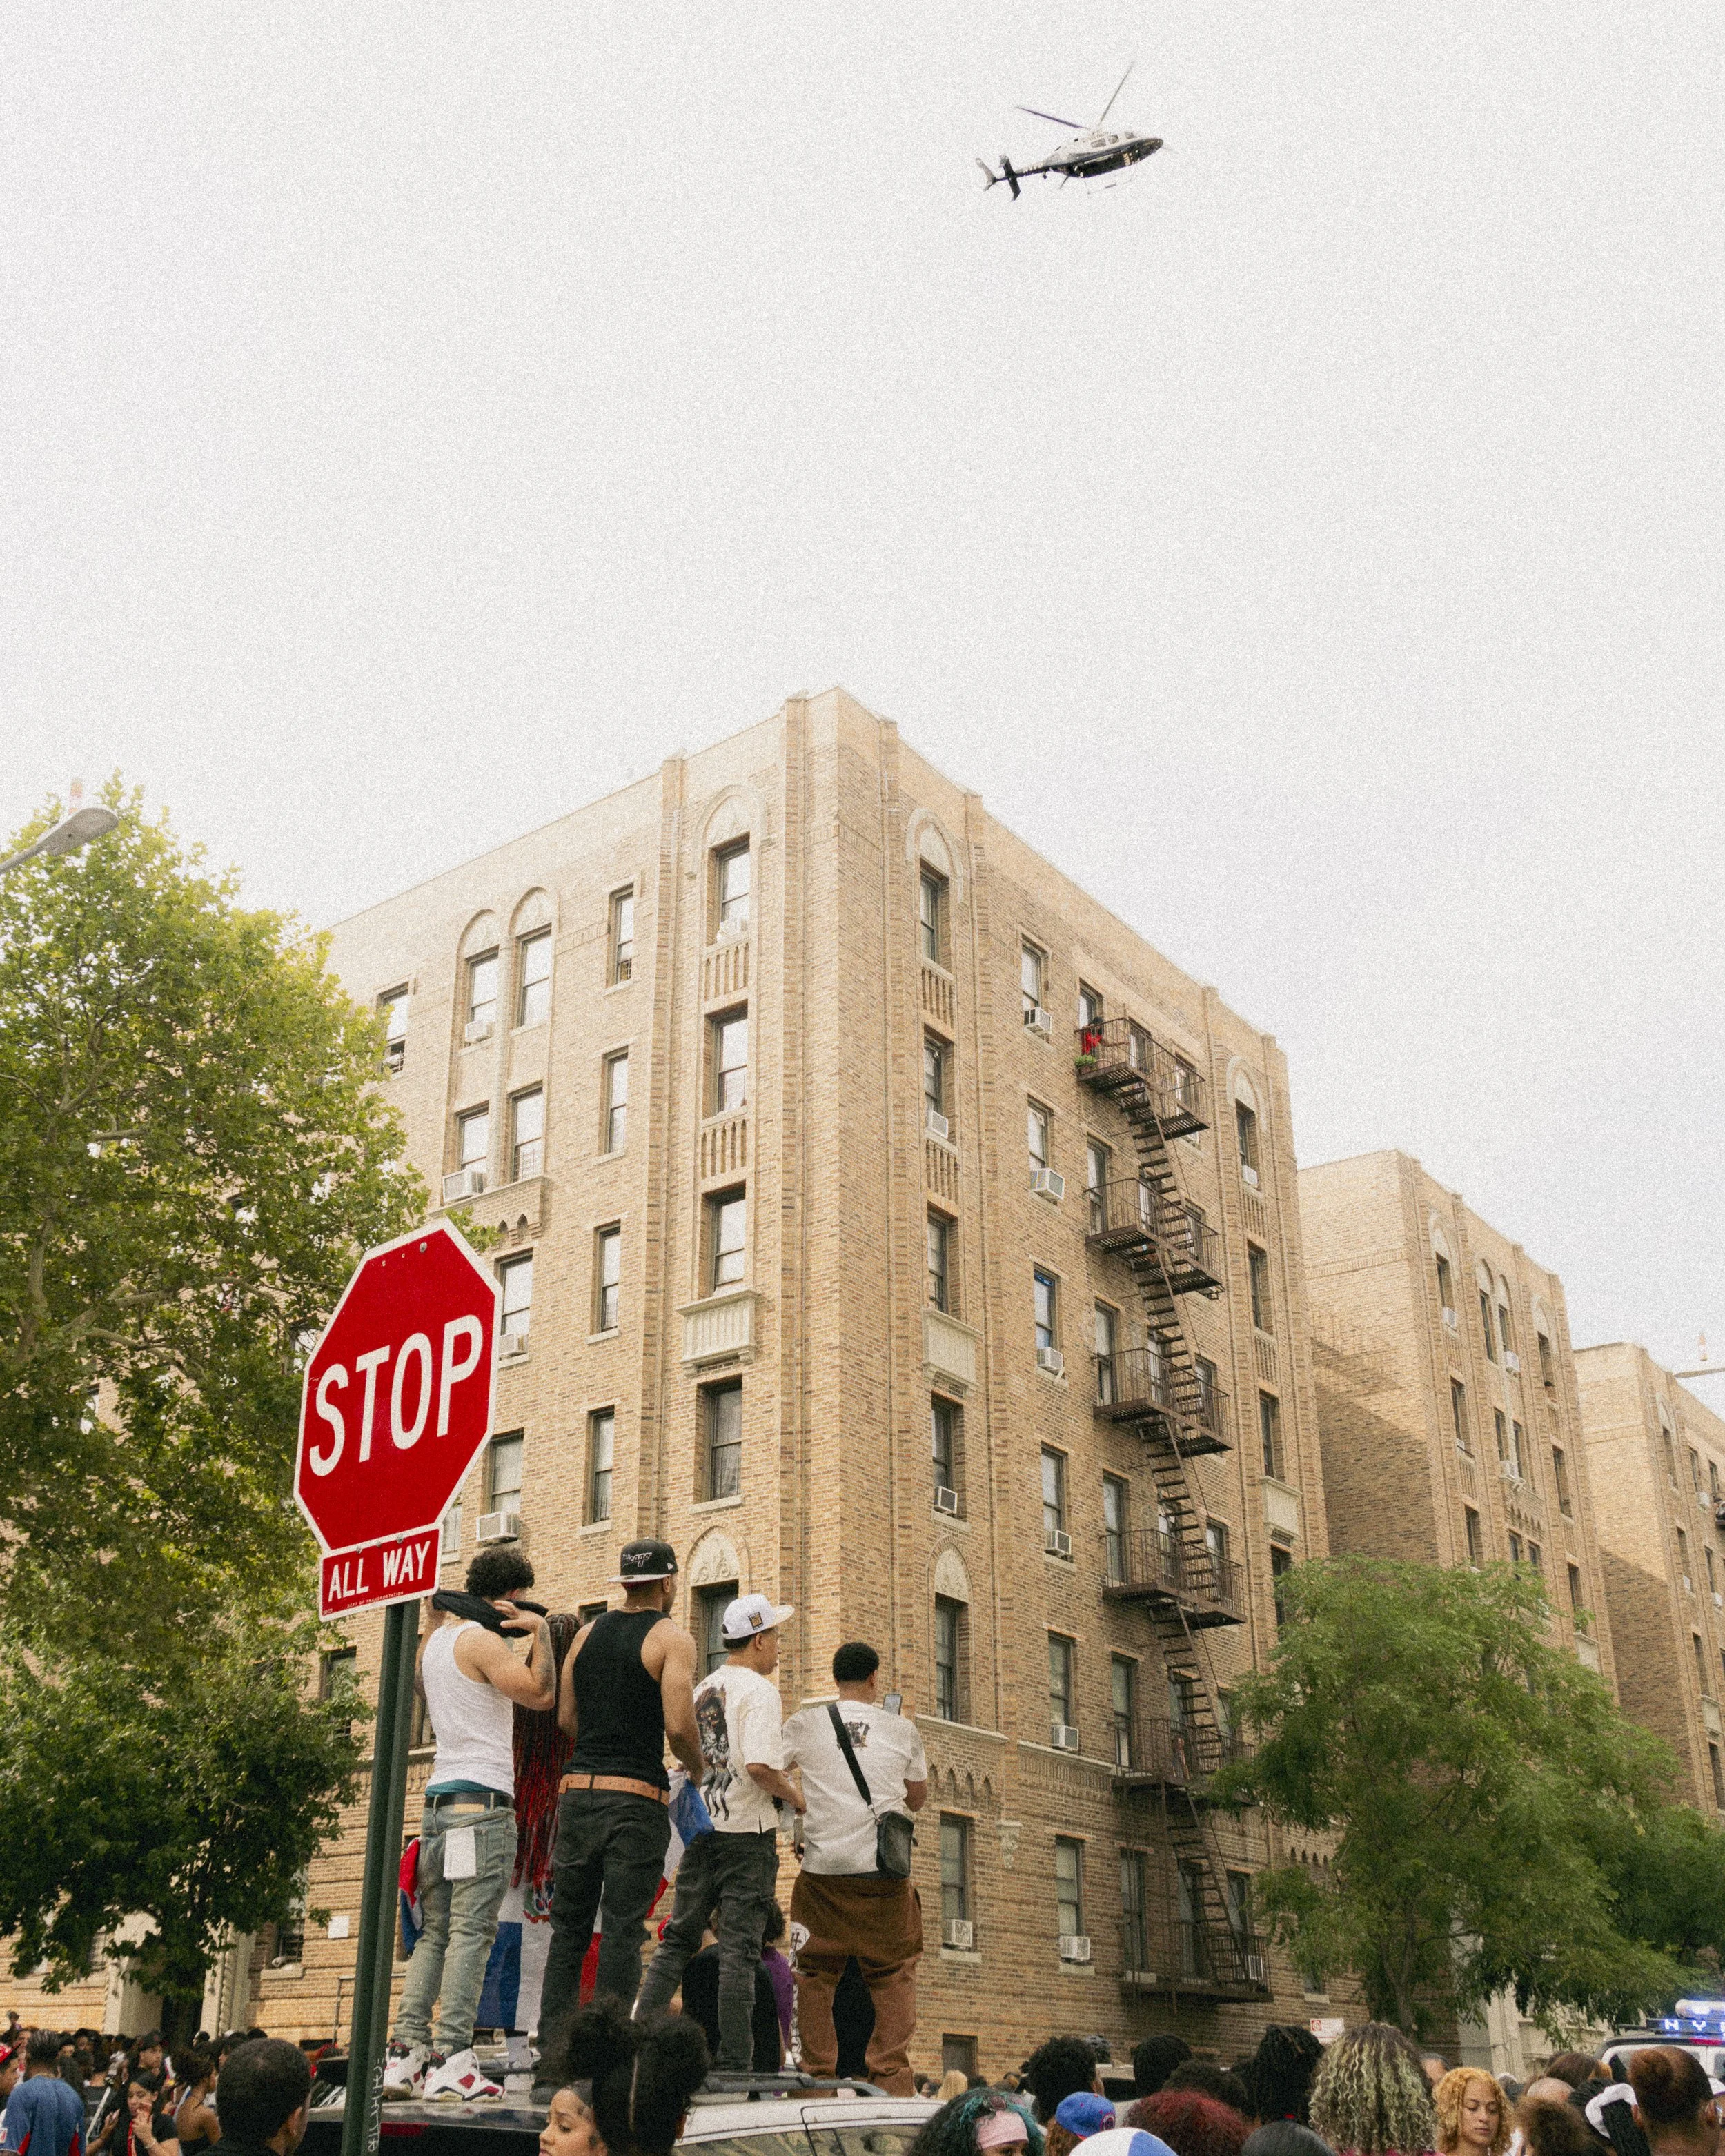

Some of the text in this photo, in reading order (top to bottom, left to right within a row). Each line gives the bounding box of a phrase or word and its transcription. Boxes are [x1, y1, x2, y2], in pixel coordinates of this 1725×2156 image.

[309, 1314, 483, 1477] STOP
[328, 1540, 431, 1603] ALL WAY
